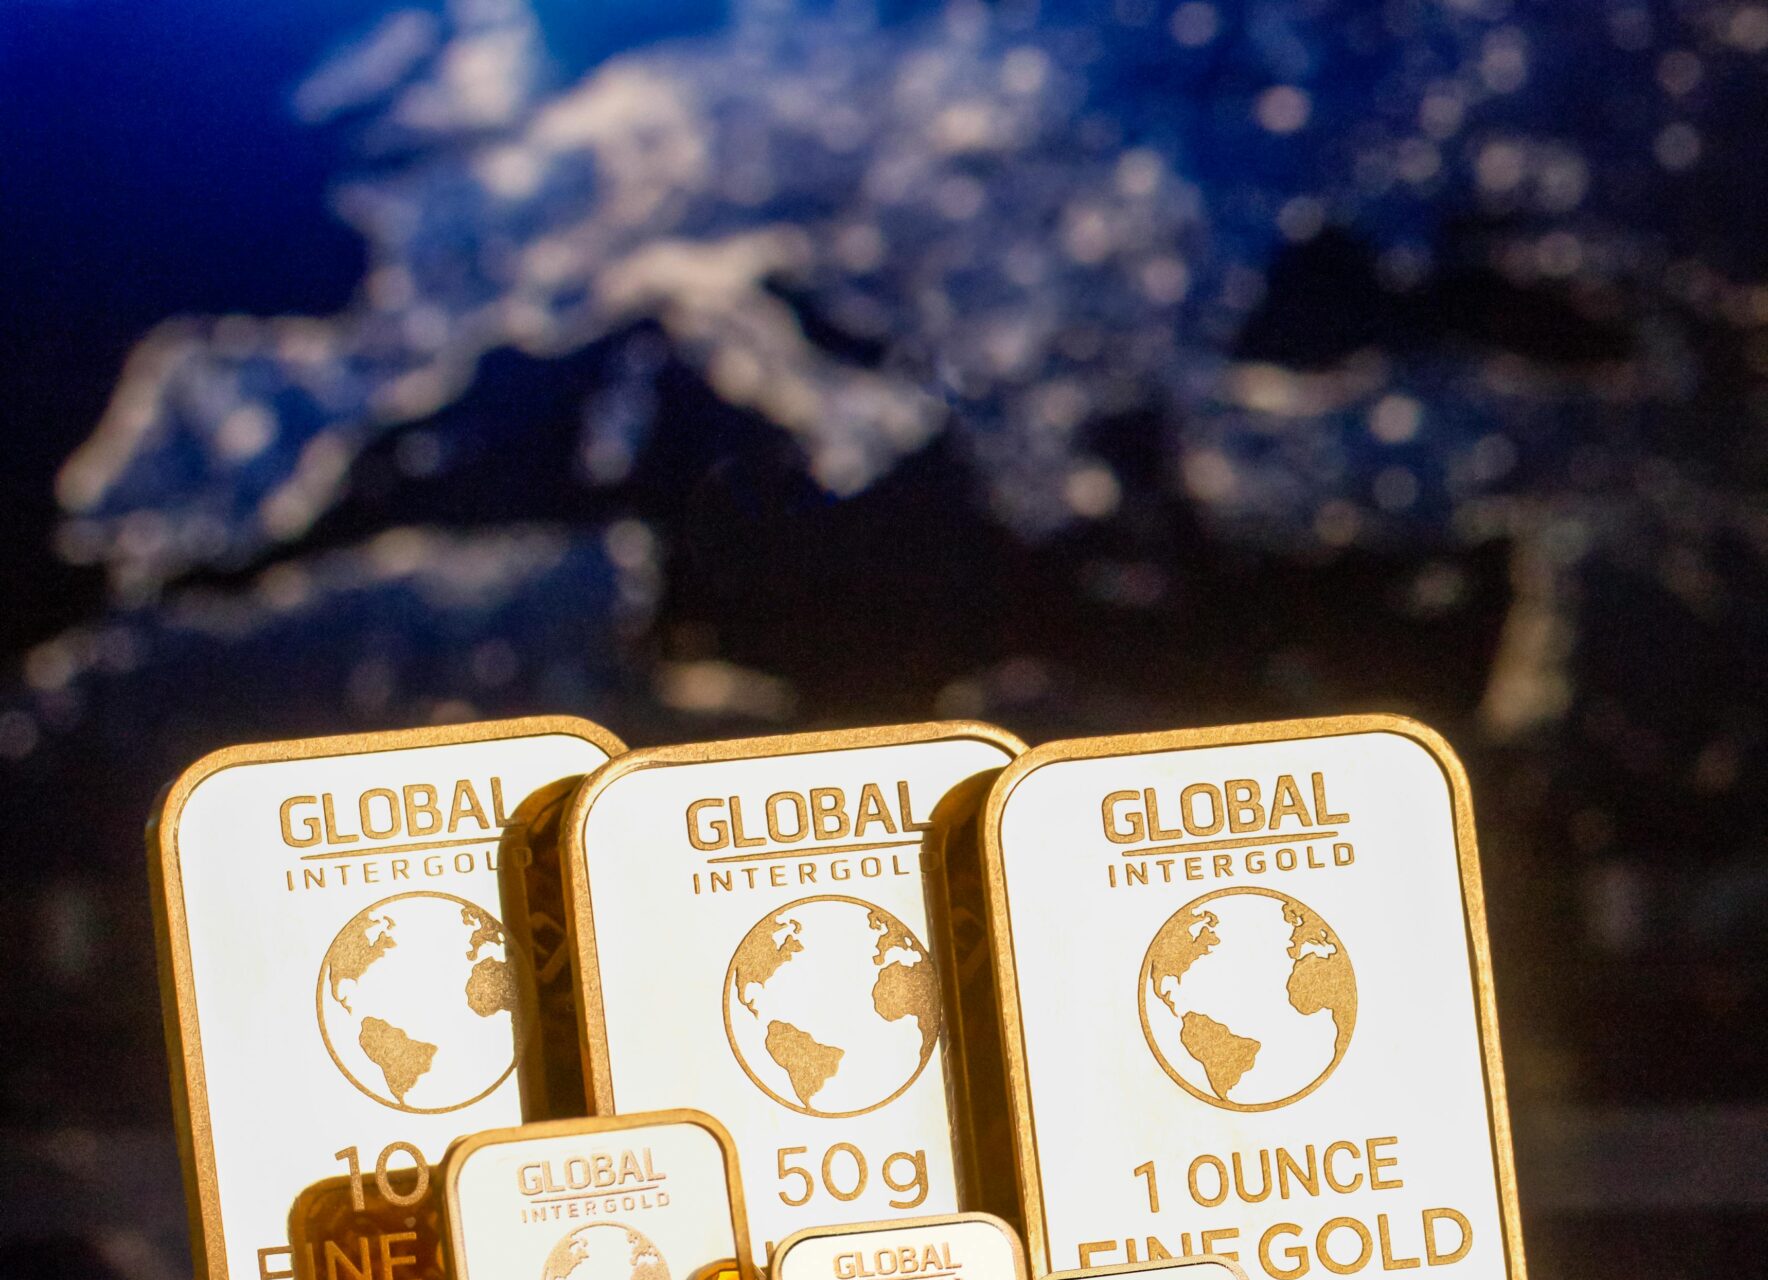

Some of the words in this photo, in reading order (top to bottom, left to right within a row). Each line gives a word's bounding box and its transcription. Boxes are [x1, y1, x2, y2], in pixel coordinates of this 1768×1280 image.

[279, 777, 526, 848] GLOBAL
[685, 780, 934, 851] GLOBAL
[1101, 772, 1351, 845] GLOBAL
[1108, 843, 1355, 888] INTERGOLD
[334, 1141, 430, 1212] 10
[517, 1147, 667, 1197] GLOBAL
[777, 1142, 930, 1210] 50g
[1134, 1160, 1160, 1213] 1
[1187, 1135, 1404, 1209] OUNCE
[520, 1192, 670, 1224] INTERGOLD
[833, 1242, 962, 1280] GLOBAL
